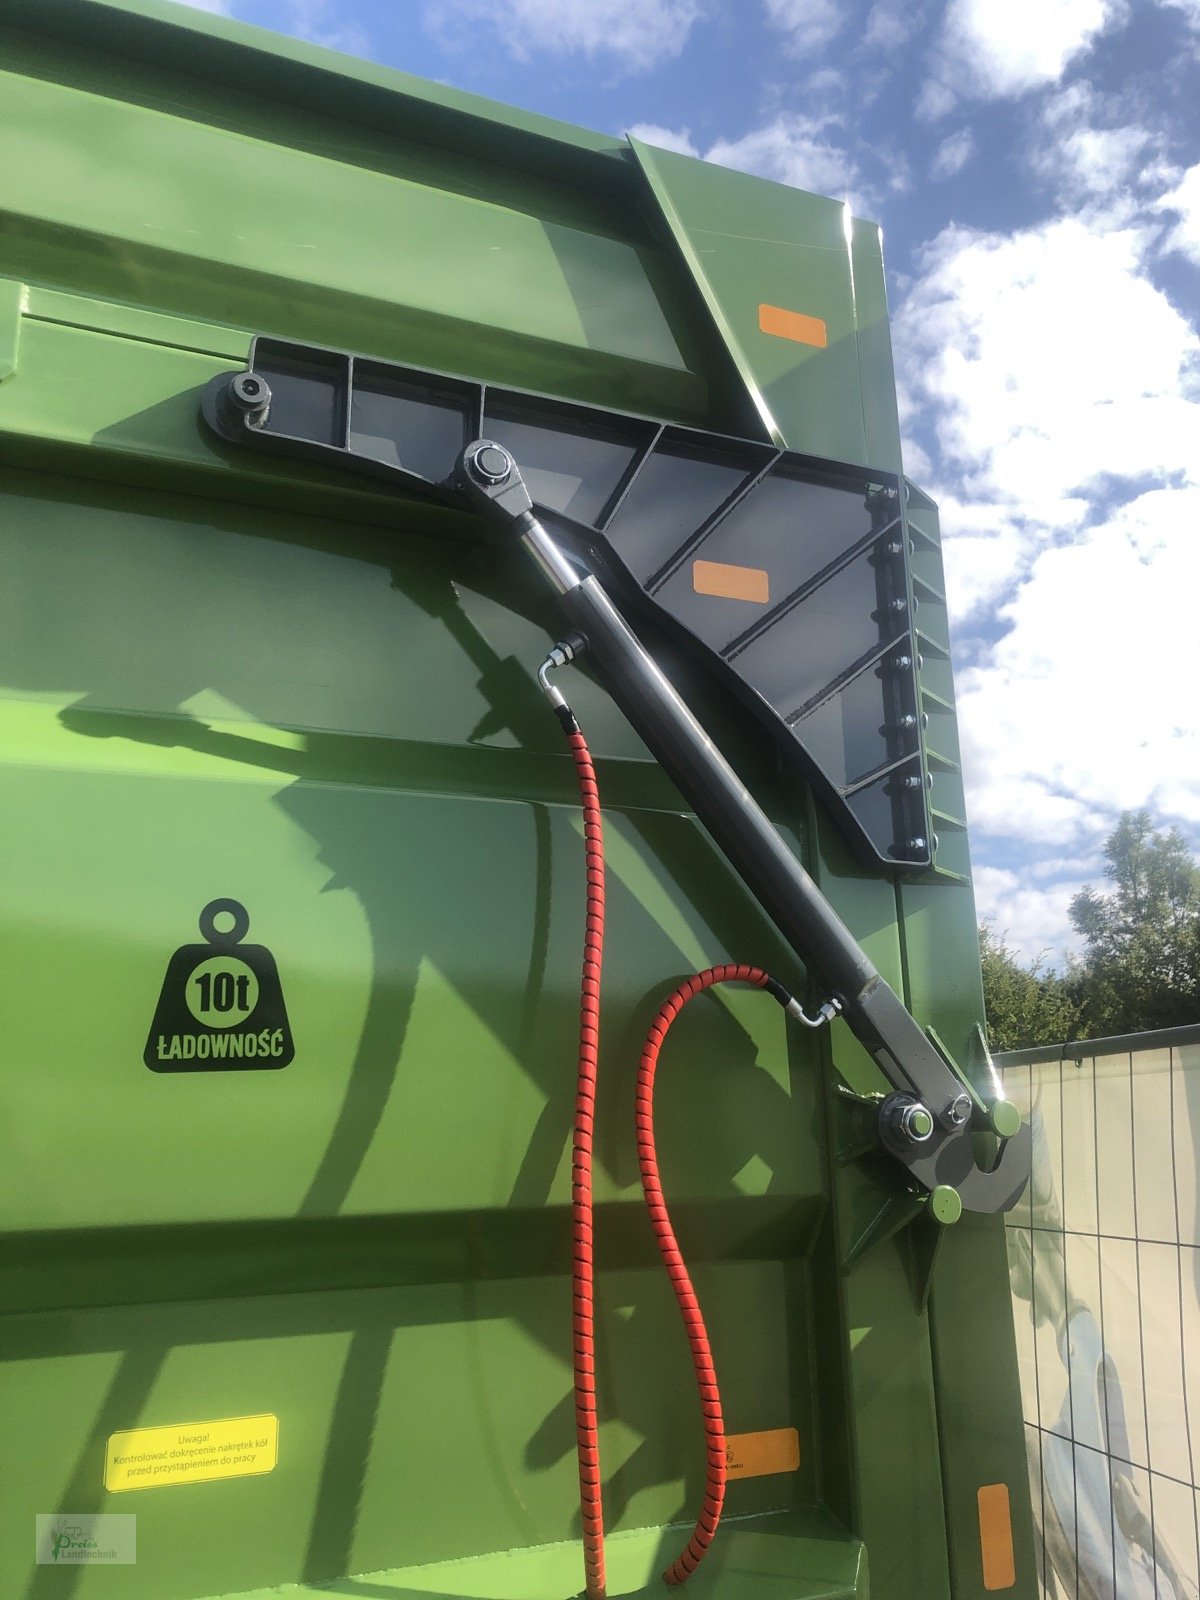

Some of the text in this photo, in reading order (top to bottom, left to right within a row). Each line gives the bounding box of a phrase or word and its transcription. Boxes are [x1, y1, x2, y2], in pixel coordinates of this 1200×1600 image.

[195, 972, 249, 1012] 10t
[157, 1028, 283, 1060] ŁADOWNOŚĆ
[113, 1437, 268, 1464] Kontrolować dokręcenie nakrętek kół
[178, 1433, 209, 1444] Uwaga!
[127, 1454, 256, 1478] przed przystąpieniem do pracy
